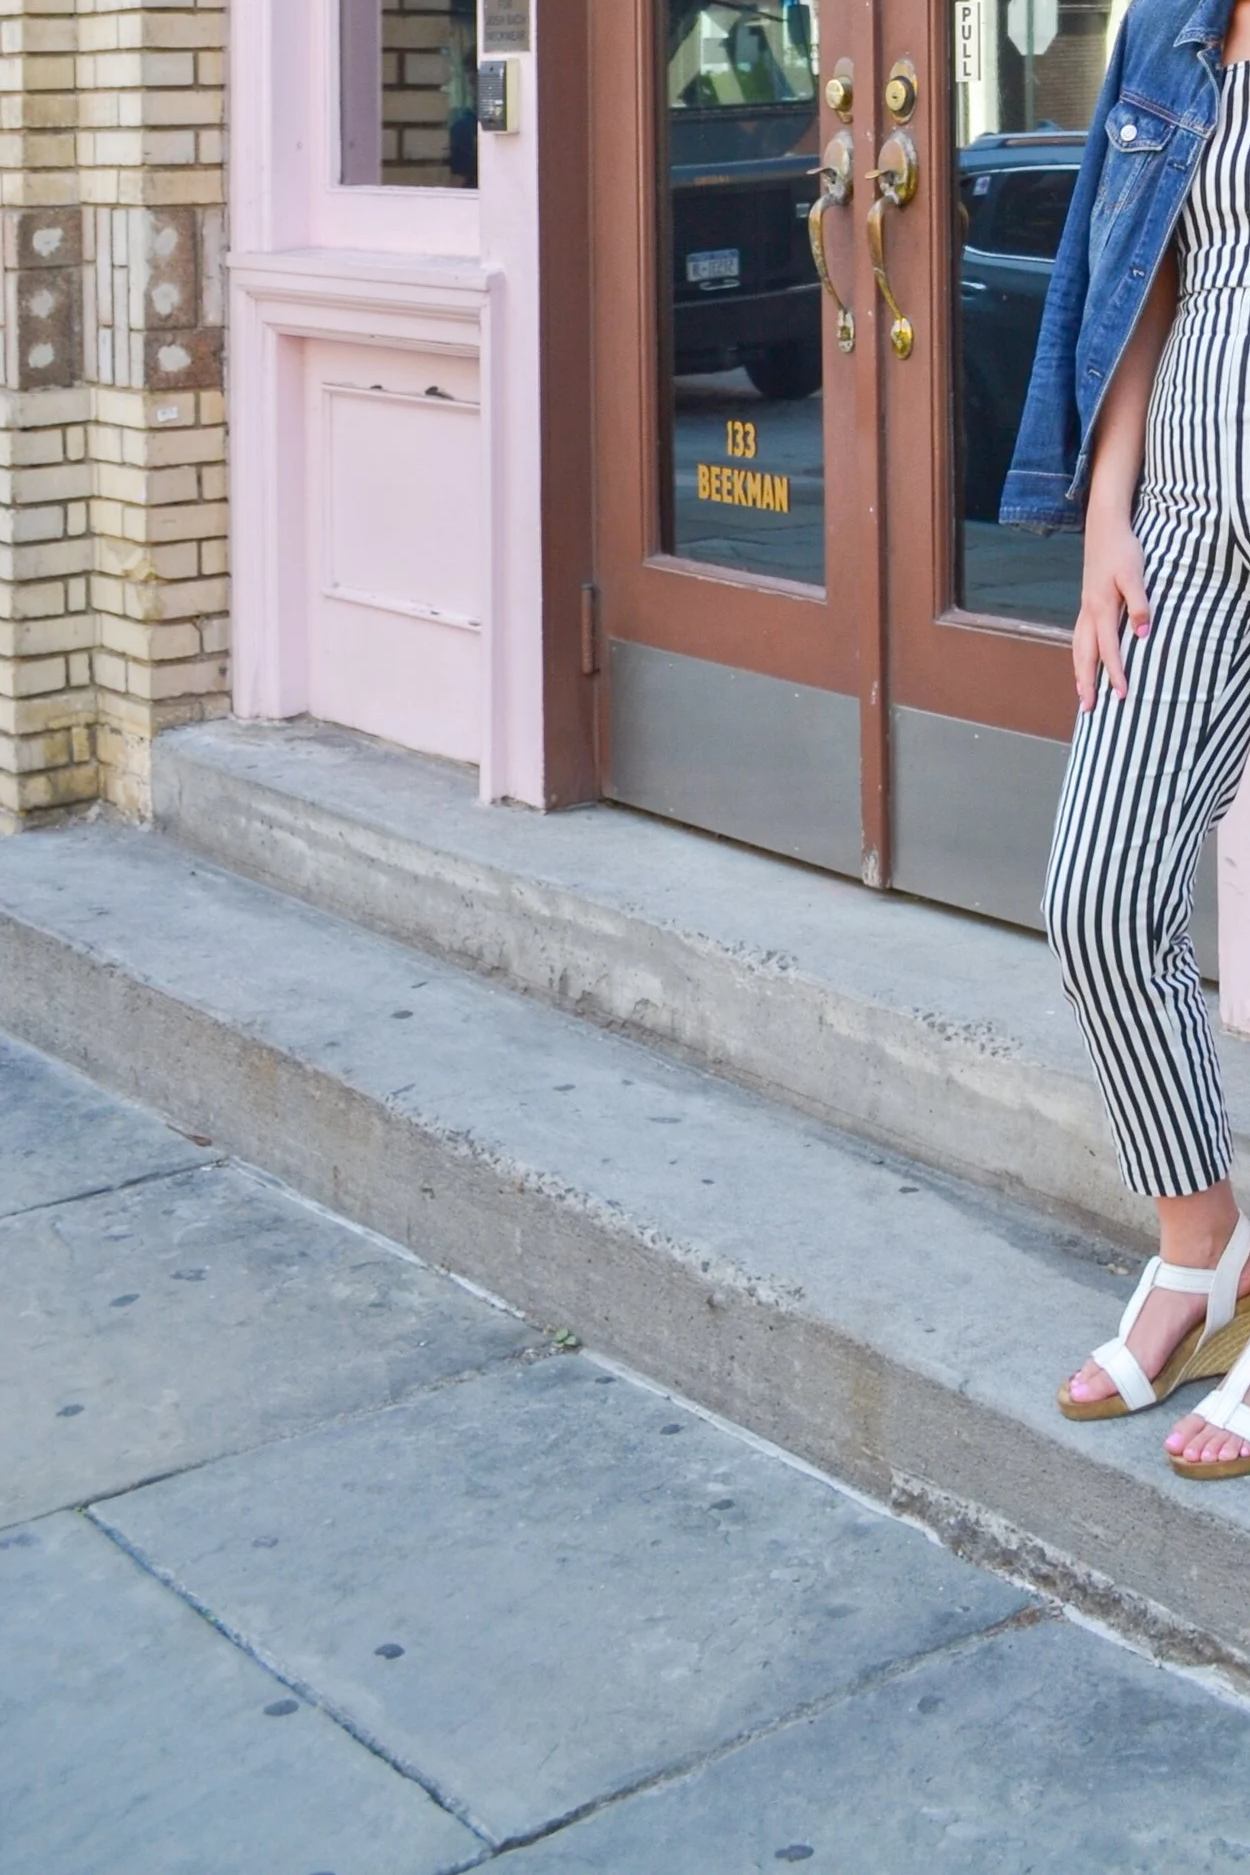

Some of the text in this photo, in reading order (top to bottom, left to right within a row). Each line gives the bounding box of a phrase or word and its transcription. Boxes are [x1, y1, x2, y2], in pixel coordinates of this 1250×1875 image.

[961, 7, 972, 77] PULL
[726, 420, 757, 459] 133
[697, 463, 790, 514] BEEKMAN
